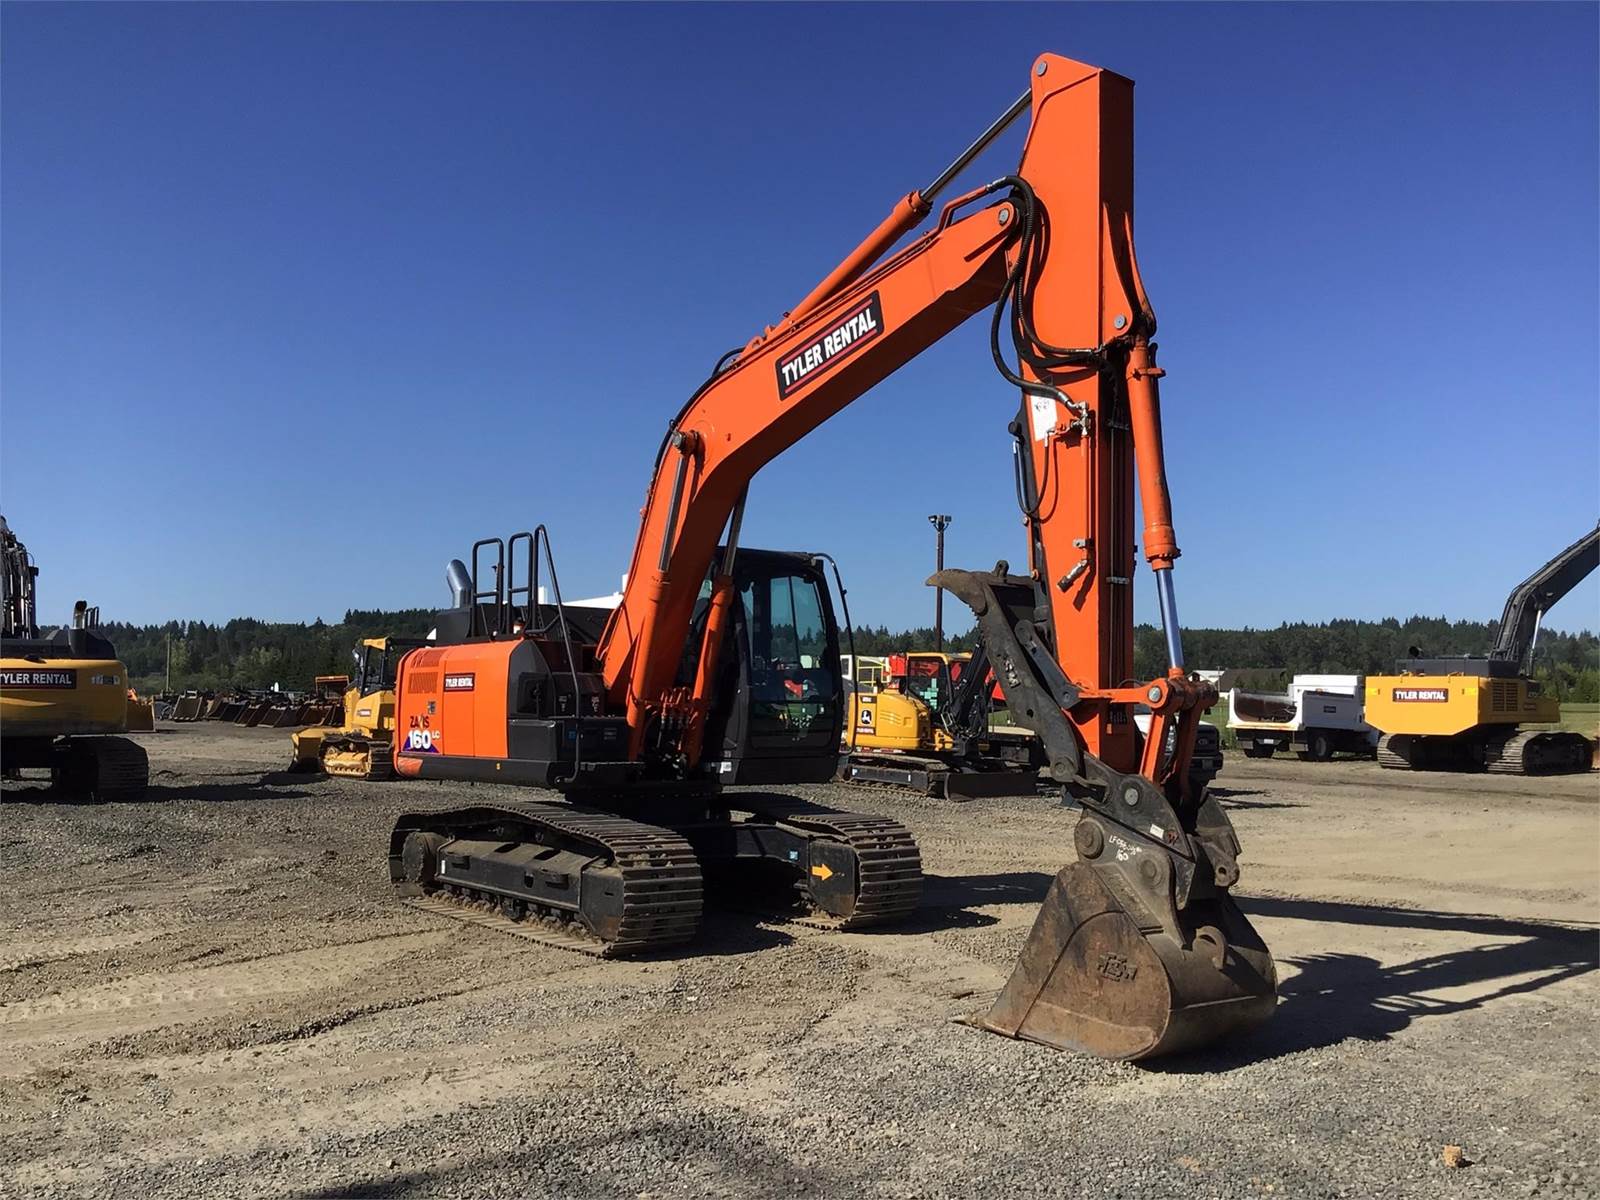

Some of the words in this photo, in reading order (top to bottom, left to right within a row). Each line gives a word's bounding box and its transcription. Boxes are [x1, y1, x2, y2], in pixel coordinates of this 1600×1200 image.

[781, 343, 823, 386] TYLER
[823, 308, 877, 359] RENTAL
[32, 673, 72, 684] RENTAL
[1395, 690, 1417, 700] TYLER
[1418, 690, 1445, 700] RENTAL
[408, 729, 432, 750] 160
